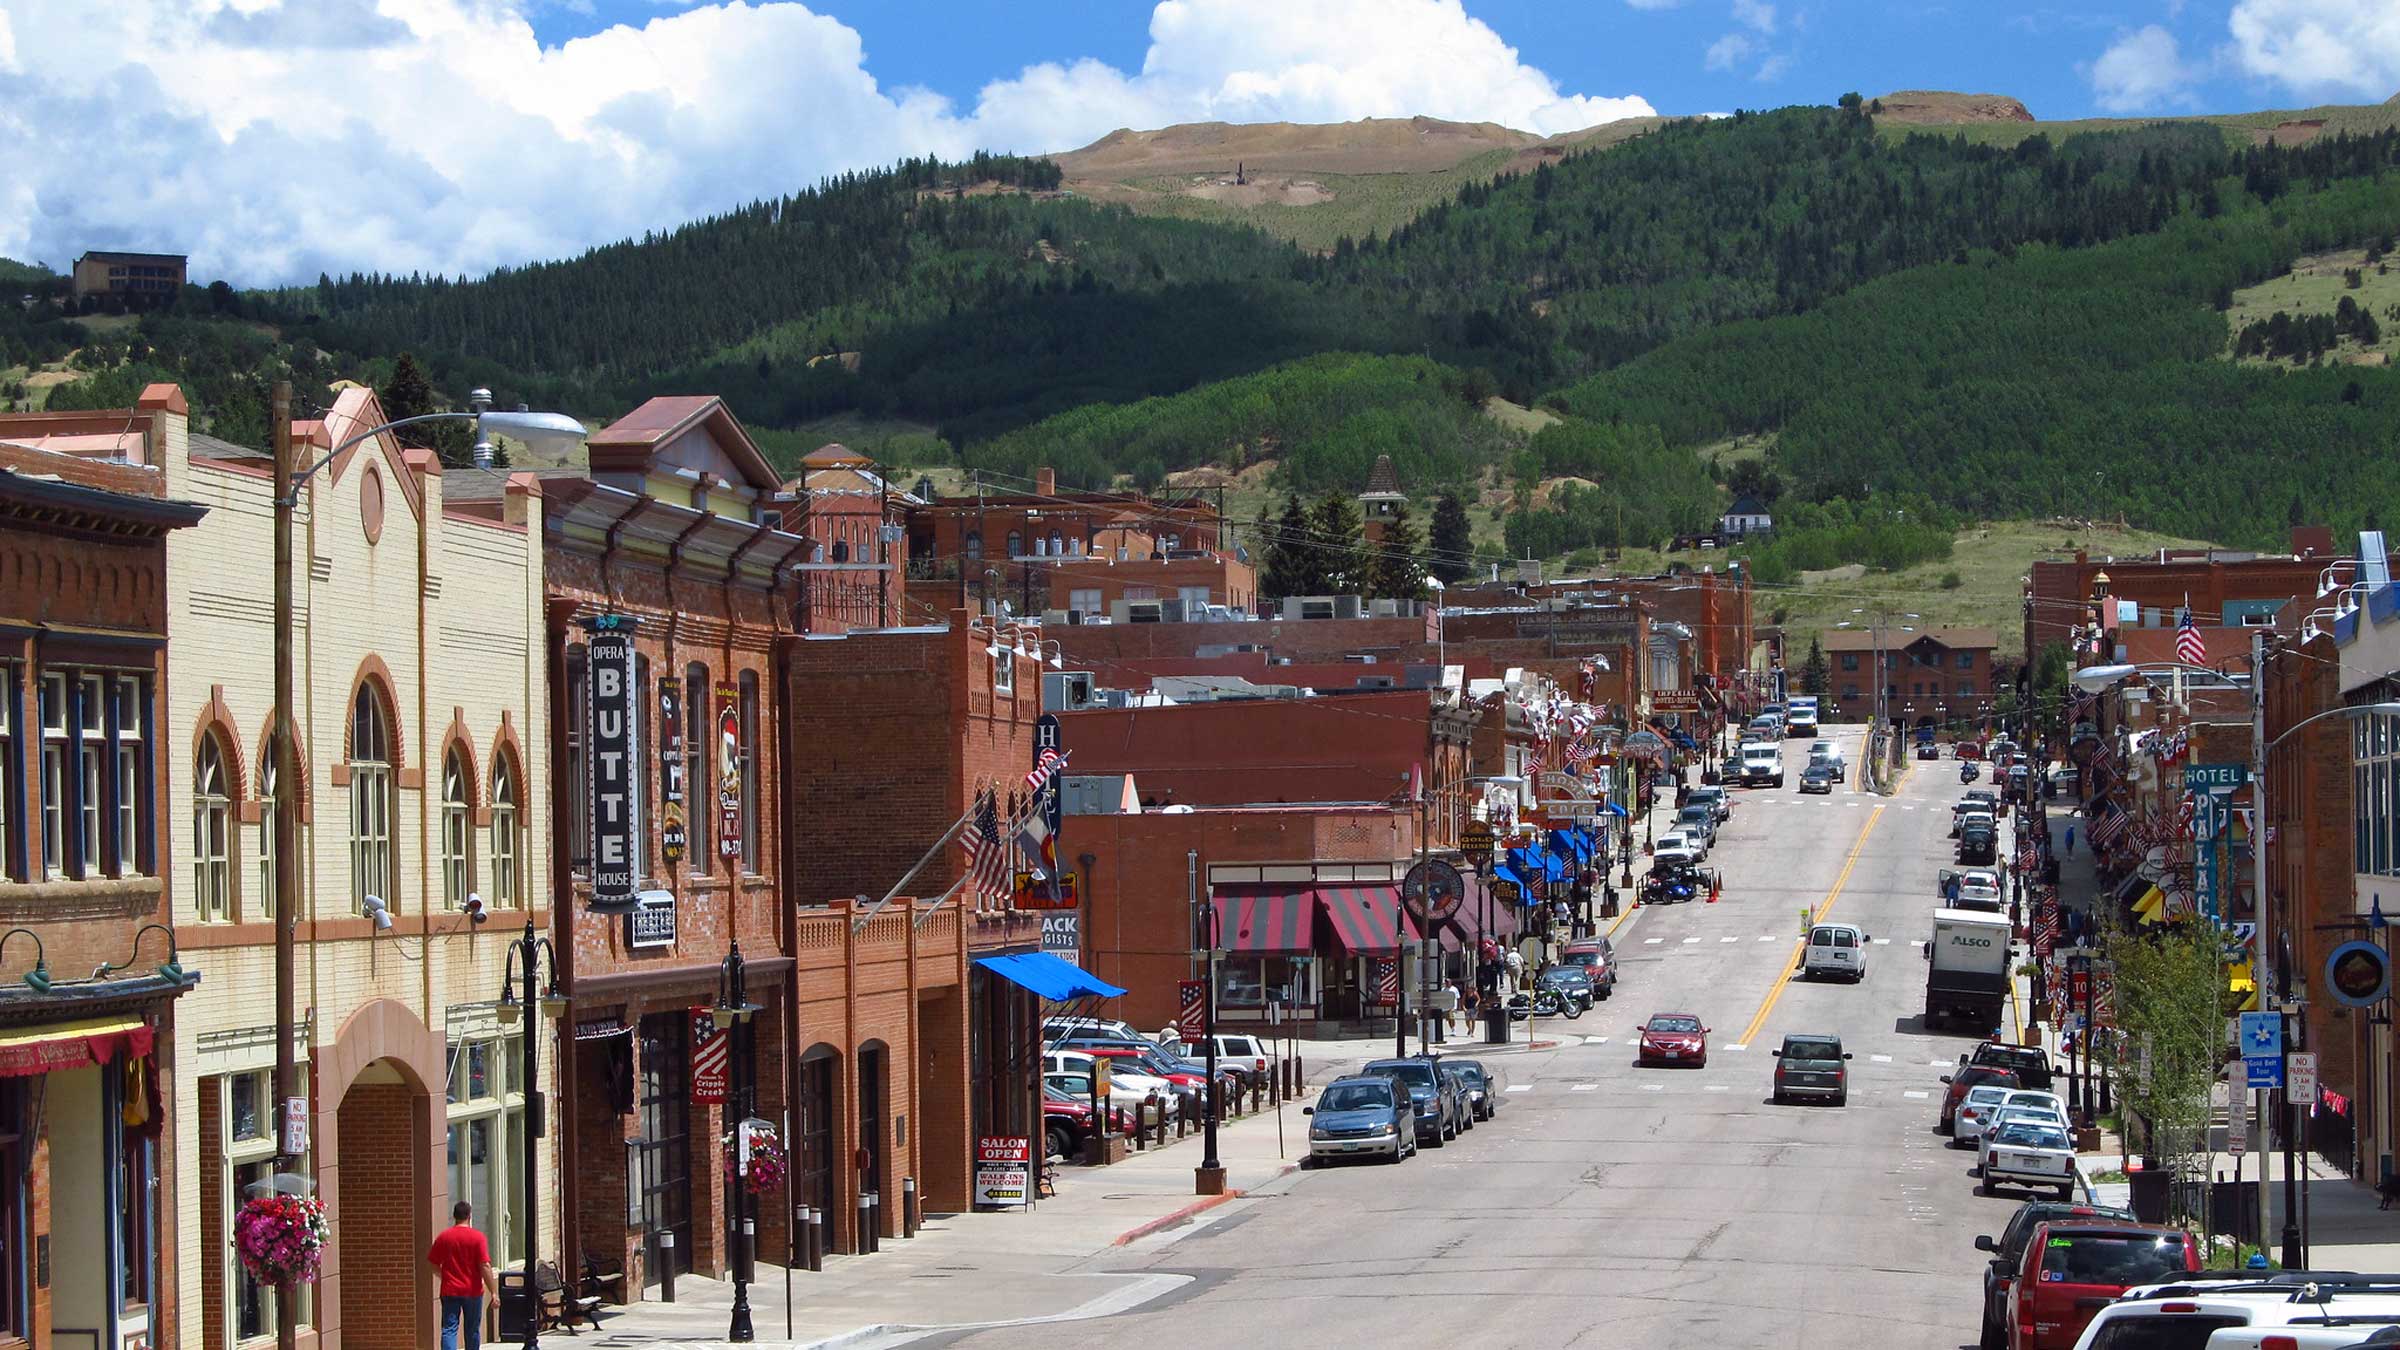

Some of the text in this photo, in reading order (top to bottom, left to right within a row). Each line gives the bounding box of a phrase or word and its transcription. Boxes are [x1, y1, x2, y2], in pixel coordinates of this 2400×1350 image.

[593, 646, 625, 660] OPERA
[598, 668, 625, 864] BUTTE
[2186, 769, 2239, 783] HOTEL
[1546, 774, 1586, 799] HOME
[2195, 794, 2210, 918] PALAC
[598, 873, 629, 886] HOUSE
[1041, 934, 1073, 946] GISTS
[1952, 936, 1991, 948] ALSCO
[2295, 1057, 2308, 1066] NO
[2256, 1067, 2270, 1075] Tour
[2288, 1067, 2315, 1075] PARKING
[696, 1080, 725, 1089] Cripple
[696, 1088, 724, 1097] Creek
[292, 1101, 302, 1112] NO
[981, 1139, 1027, 1148] SALON
[985, 1149, 1022, 1158] OPEN
